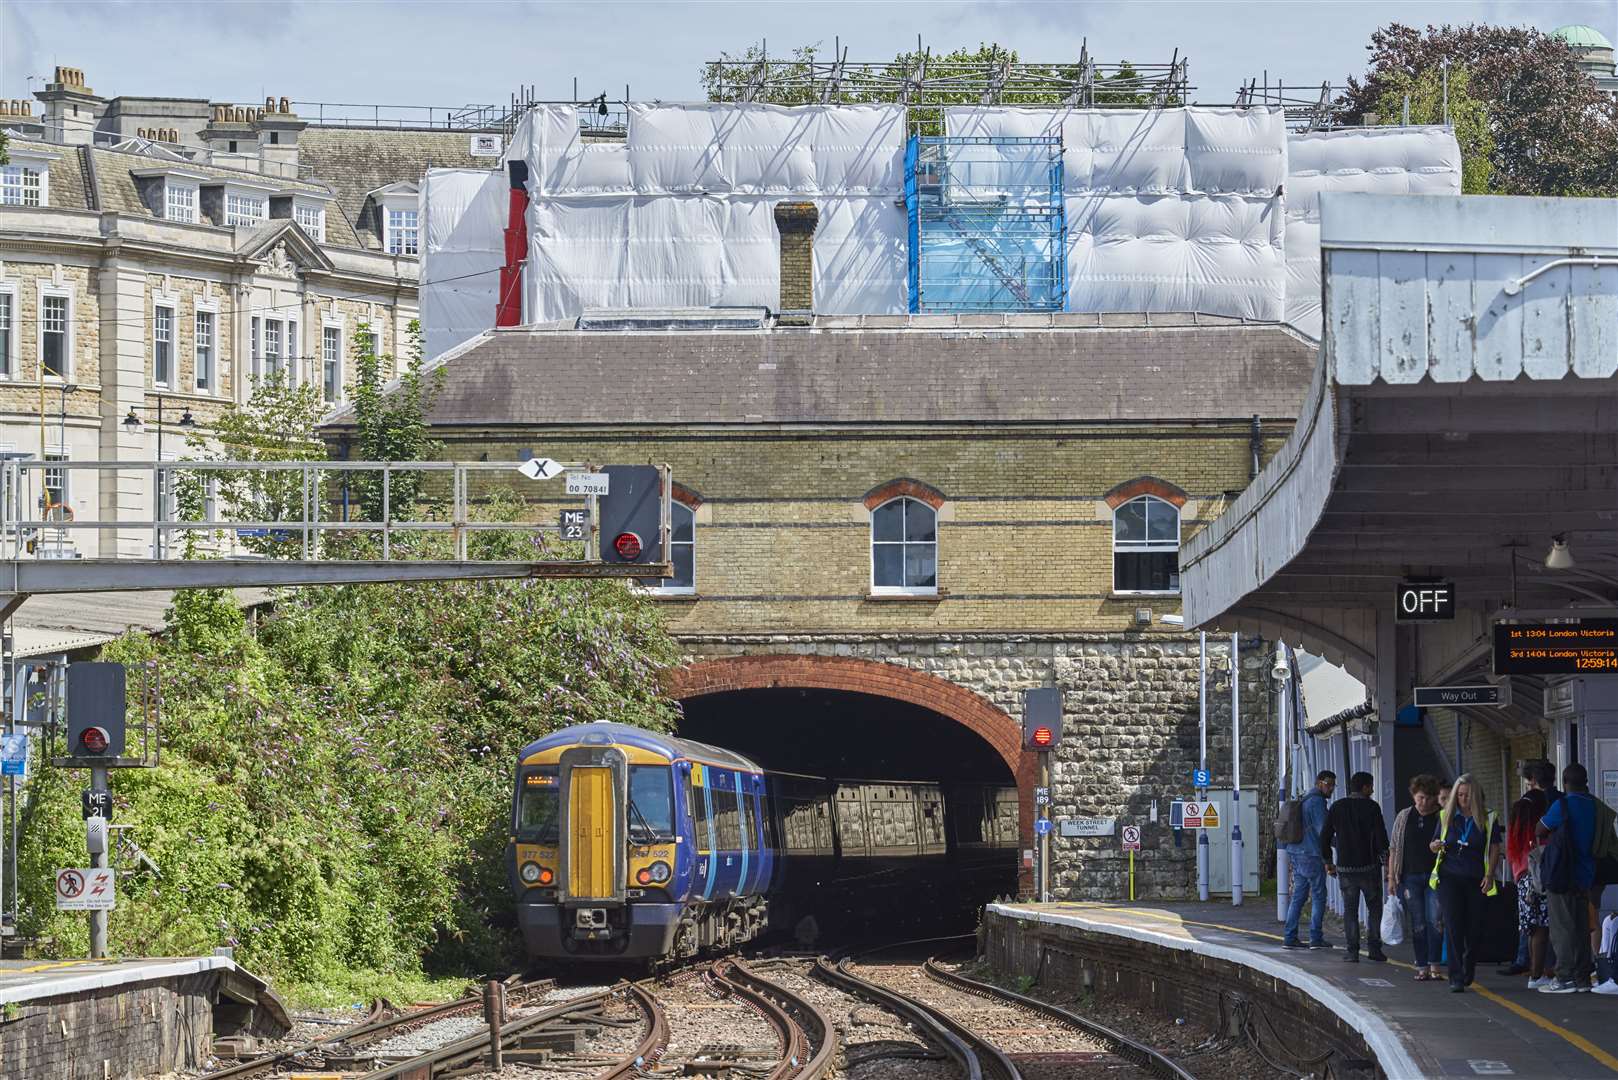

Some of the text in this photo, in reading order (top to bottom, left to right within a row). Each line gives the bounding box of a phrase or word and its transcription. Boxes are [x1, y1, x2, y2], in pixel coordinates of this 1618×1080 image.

[534, 460, 548, 477] X
[569, 484, 580, 492] 00
[565, 512, 584, 523] ME
[567, 525, 582, 537] 23
[1402, 590, 1447, 612] OFF
[1510, 630, 1522, 638] 1st
[1580, 629, 1614, 637] Victoria
[1509, 649, 1614, 658] 3rd 14:04 London Victoria
[1575, 658, 1618, 668] 12:59:14
[1441, 691, 1478, 702] Way Out
[1197, 771, 1207, 782] S
[1036, 787, 1049, 796] ME
[89, 793, 106, 804] ME
[1036, 796, 1049, 804] 189
